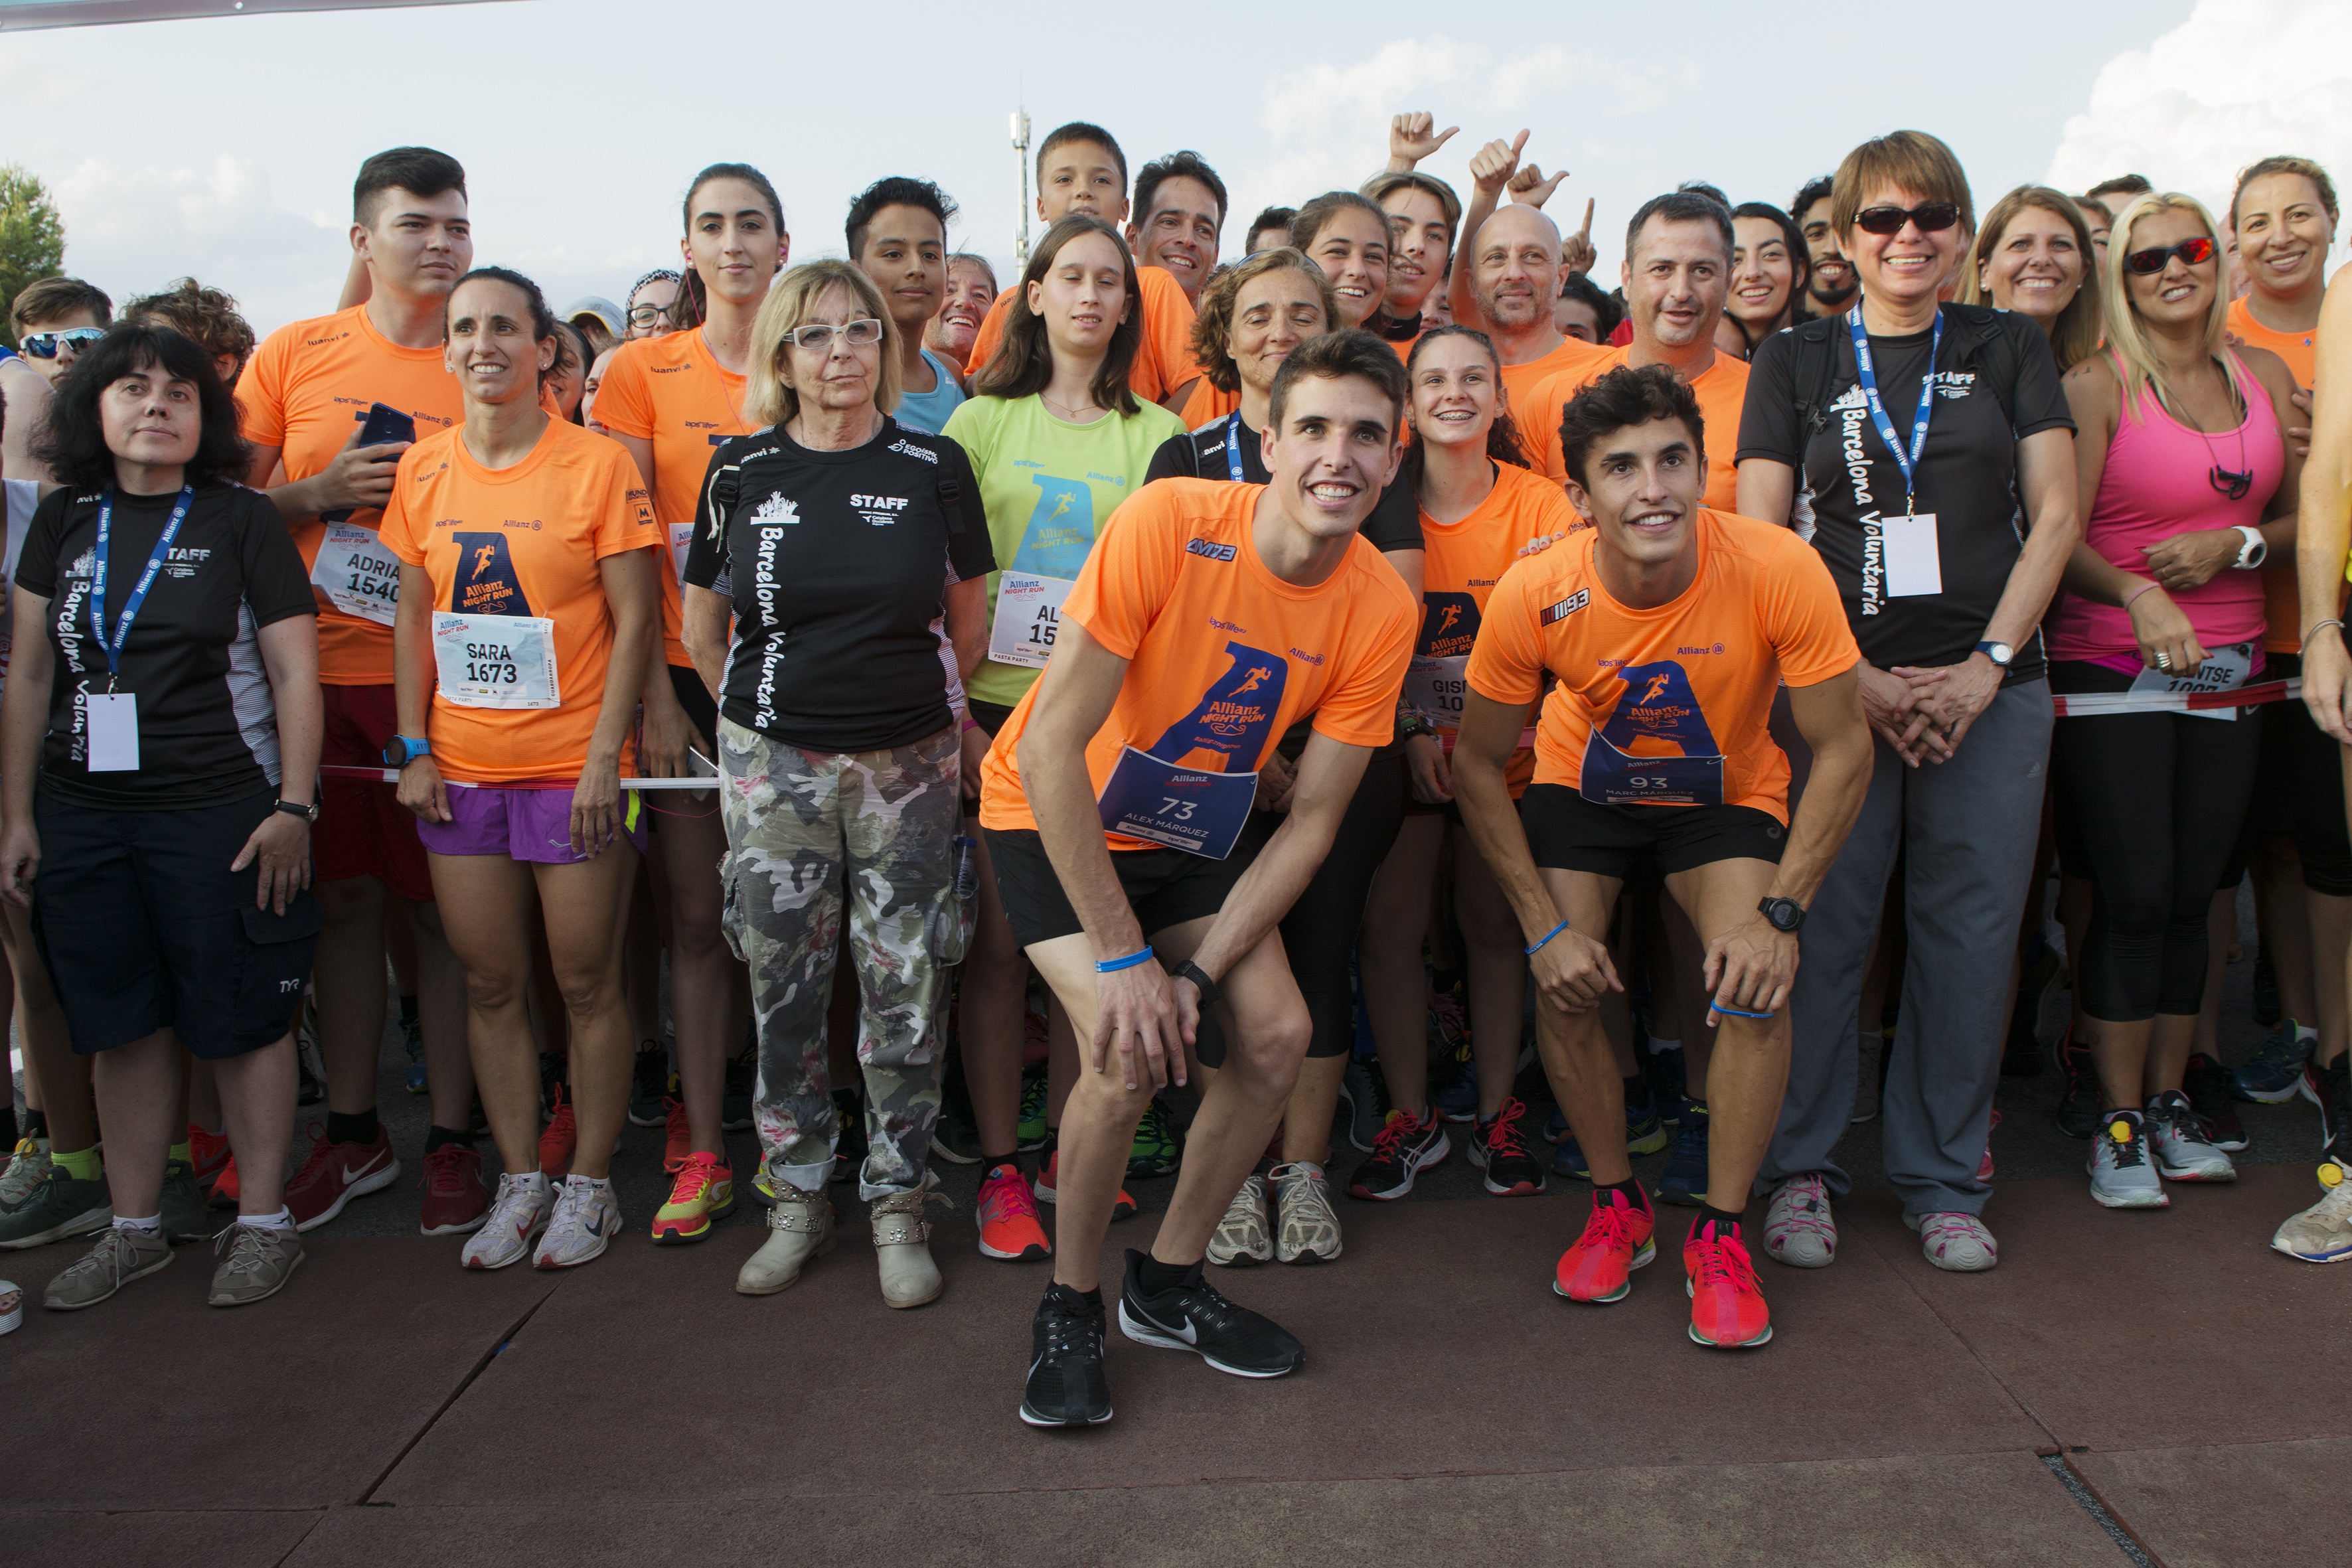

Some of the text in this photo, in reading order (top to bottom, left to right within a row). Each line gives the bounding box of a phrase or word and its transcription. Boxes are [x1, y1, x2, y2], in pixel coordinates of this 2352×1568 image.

[307, 335, 339, 346] luanvi
[1860, 348, 1871, 371] Allianz
[412, 412, 441, 424] Allianz
[1889, 439, 1908, 466] Allianz
[1911, 432, 1924, 462] Allianz
[903, 449, 938, 464] POSITIVO
[1842, 409, 1874, 505] Barcelona
[1086, 472, 1114, 482] Allianz
[850, 494, 908, 510] STAFF
[101, 507, 110, 532] Allianz
[162, 517, 180, 542] Allianz
[1038, 528, 1078, 540] Allianz
[1031, 536, 1085, 550] NIGHT RUN
[168, 548, 211, 561] TAFF
[1859, 510, 1885, 615] Voluntaria
[96, 560, 106, 585] Allianz
[755, 527, 784, 627] Barcelona
[136, 570, 155, 594] Allianz
[465, 581, 505, 597] Allianz
[463, 588, 513, 607] NIGHT RUN
[57, 580, 92, 672] Barcelona
[93, 612, 104, 640] Allianz
[437, 627, 455, 636] NIGHT
[440, 619, 464, 629] Allianz
[114, 621, 129, 649] Allianz
[1431, 635, 1472, 651] Allianz
[467, 643, 512, 661] SARA
[1459, 641, 1475, 652] RU
[466, 663, 517, 683] 1673
[755, 631, 786, 728] Voluntaria
[1210, 701, 1261, 715] Allianz
[1630, 705, 1680, 716] Allianz
[1664, 708, 1690, 718] RUN
[1199, 713, 1266, 724] NIGHT RUN
[1630, 777, 1668, 789] 93
[1156, 797, 1198, 820] 73
[1125, 813, 1210, 838] ALEX MÁRQUEZ
[1125, 825, 1146, 834] Allianz
[279, 979, 300, 993] TYR
